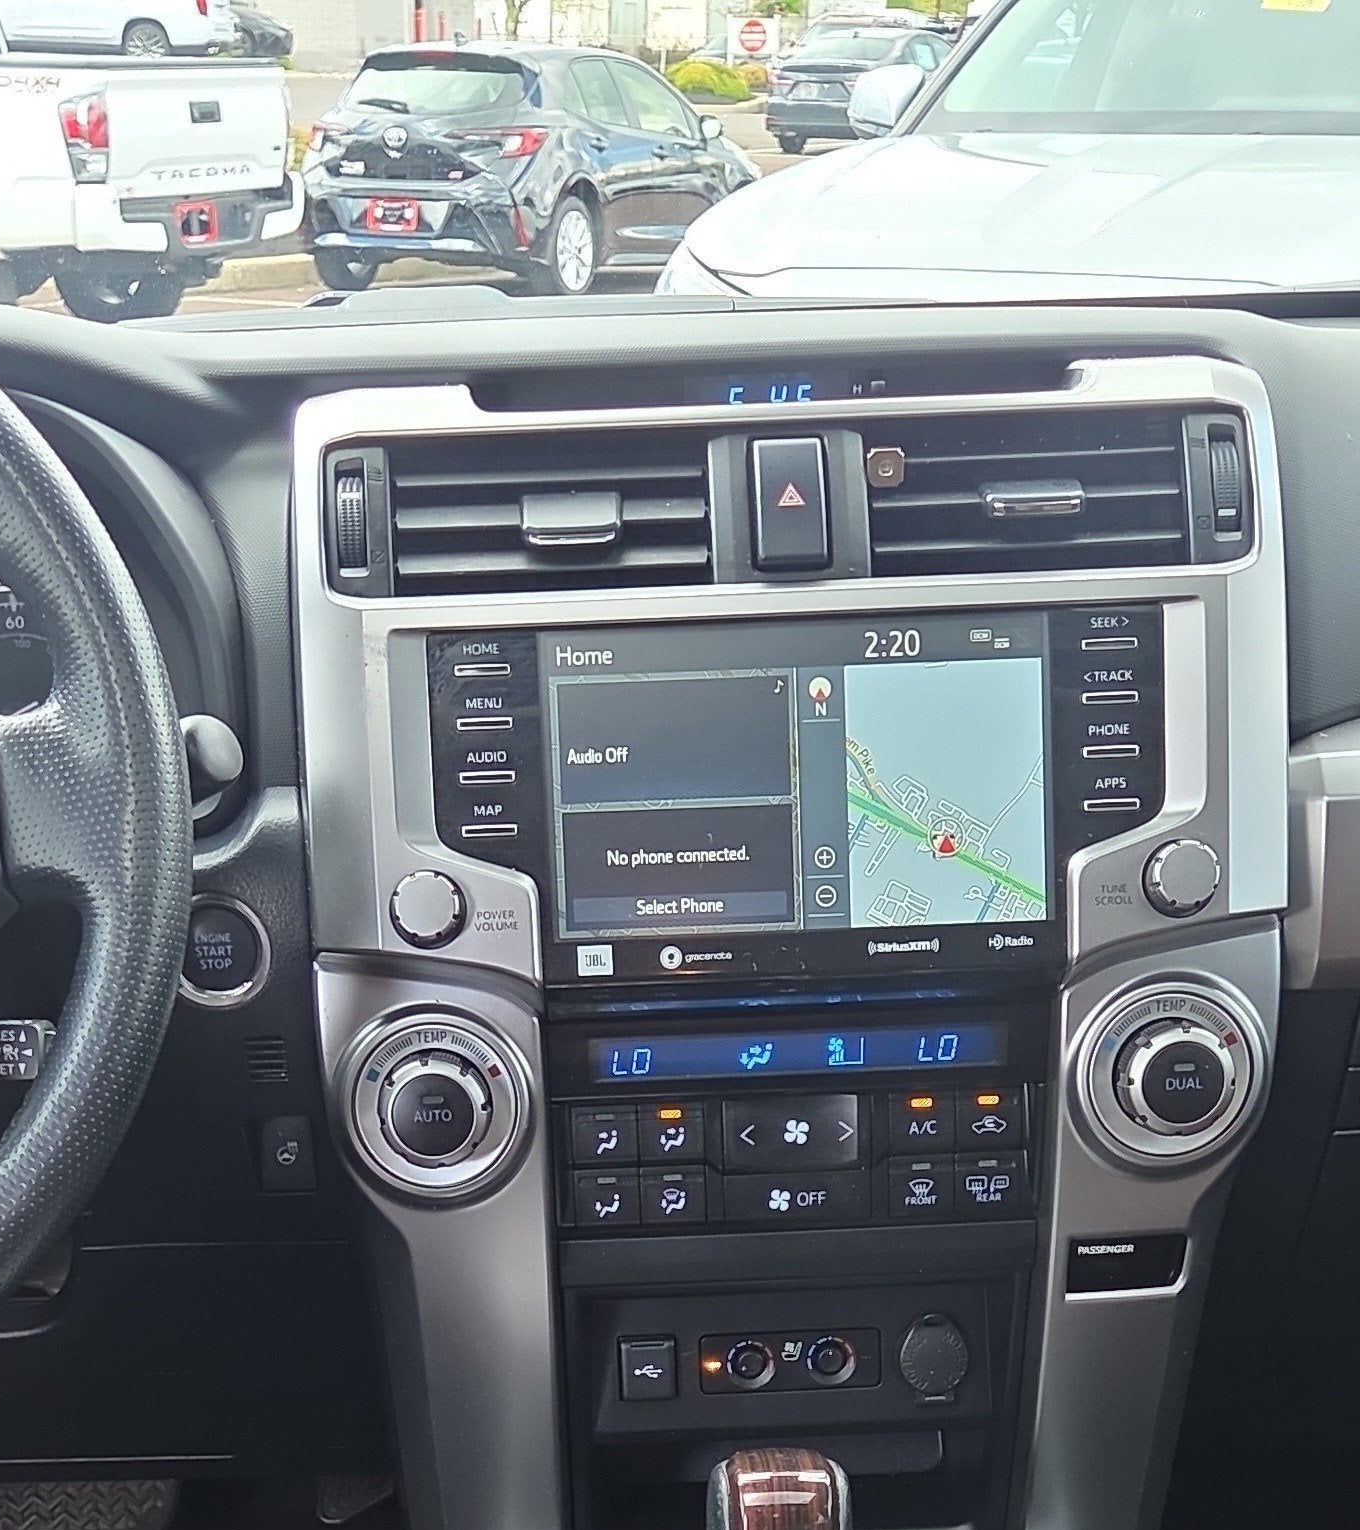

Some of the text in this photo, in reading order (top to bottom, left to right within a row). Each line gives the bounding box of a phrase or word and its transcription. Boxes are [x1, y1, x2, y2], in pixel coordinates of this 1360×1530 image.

[151, 164, 251, 180] TACOMA
[5, 615, 26, 629] 60
[463, 643, 500, 655] HOME
[864, 629, 921, 658] 2:20
[555, 646, 614, 667] Home
[465, 697, 502, 709] MENU
[815, 702, 827, 716] N
[1088, 724, 1130, 736] PHONE
[466, 751, 507, 763] AUDIO
[567, 747, 629, 765] Audio Off
[857, 747, 876, 776] Pike
[1095, 777, 1127, 790] APPS
[473, 804, 503, 817] MAP
[607, 845, 750, 868] No phone connected.
[1101, 884, 1127, 894] TUNE
[636, 897, 724, 916] Select Phone
[1094, 894, 1133, 906] SCROLL
[476, 910, 515, 921] POWER
[474, 921, 519, 932] VOLUME
[1005, 935, 1034, 947] Radio
[195, 945, 233, 957] START
[200, 958, 232, 969] STOP
[585, 953, 607, 968] JBL
[1155, 999, 1186, 1013] TEMP
[416, 1031, 448, 1044] TEMP
[917, 1034, 959, 1062] LO
[611, 1048, 652, 1076] LO
[1165, 1077, 1203, 1091] DUAL
[413, 1110, 453, 1123] AUTO
[908, 1119, 938, 1135] A/C
[796, 1191, 827, 1207] OFF
[905, 1195, 937, 1206] FRONT
[975, 1192, 1002, 1202] REAR
[1077, 1244, 1134, 1255] PASSENGER
